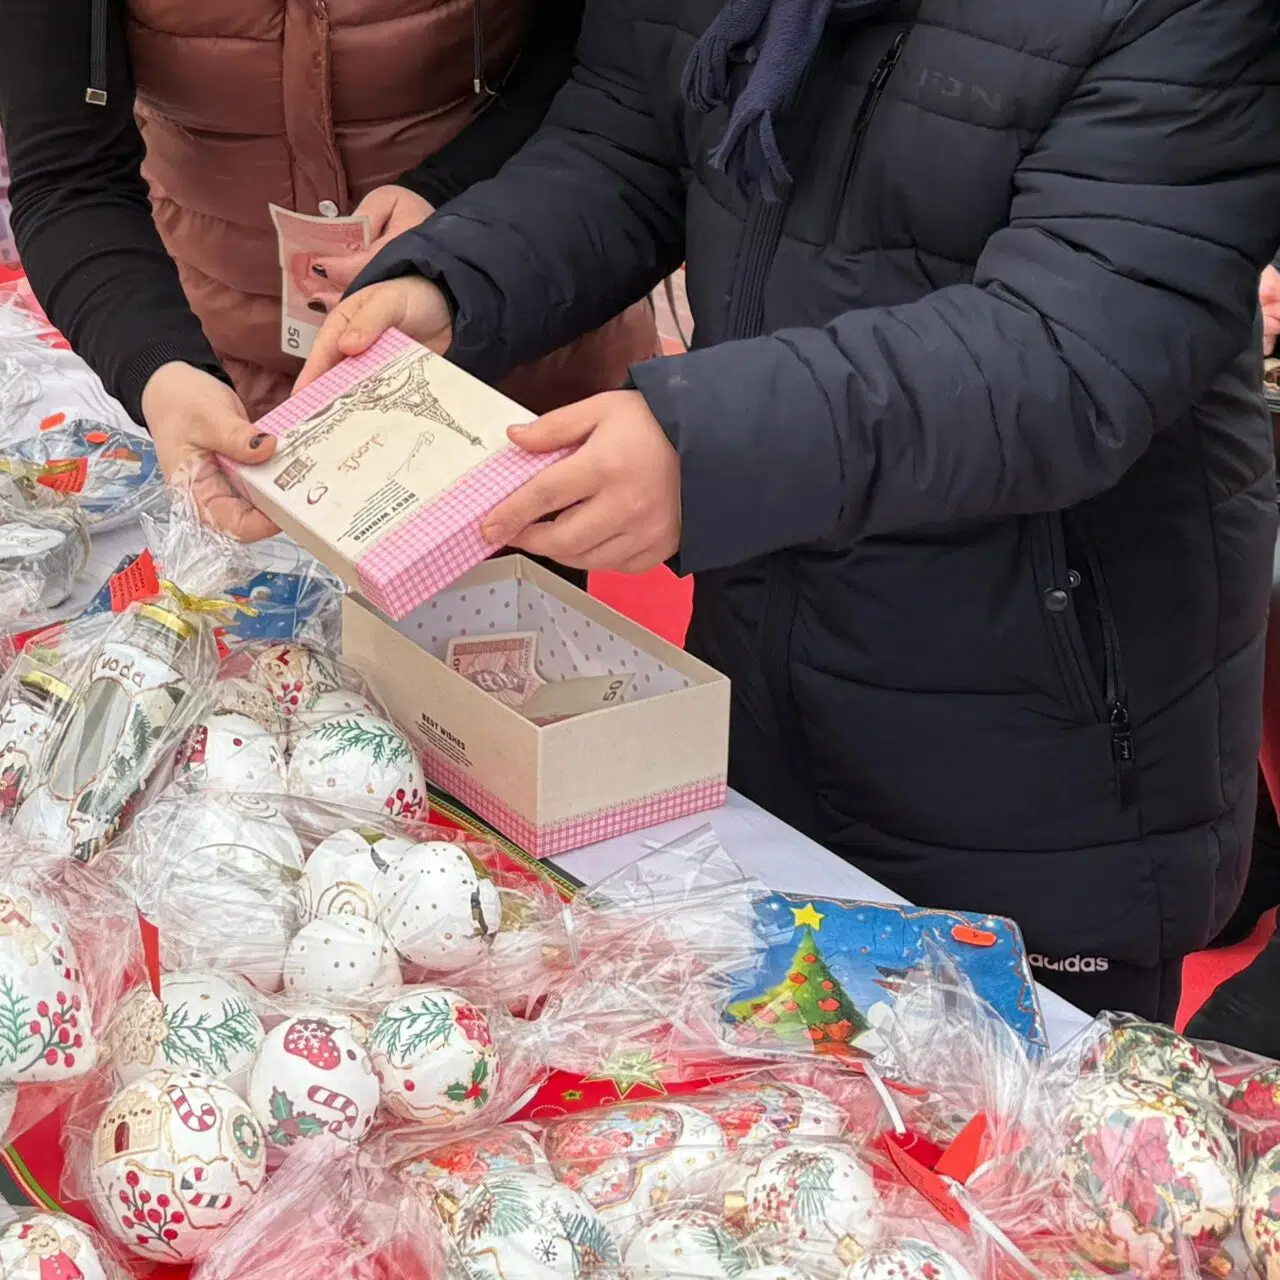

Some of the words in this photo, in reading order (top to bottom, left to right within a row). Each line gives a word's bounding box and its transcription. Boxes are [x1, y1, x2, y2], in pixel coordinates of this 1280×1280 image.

[288, 326, 300, 350] 50
[391, 492, 417, 511] BEST
[353, 511, 390, 541] WISHES
[602, 679, 624, 702] 50
[421, 712, 438, 731] BEST
[440, 726, 466, 751] WISHES
[1027, 954, 1109, 972] adidas
